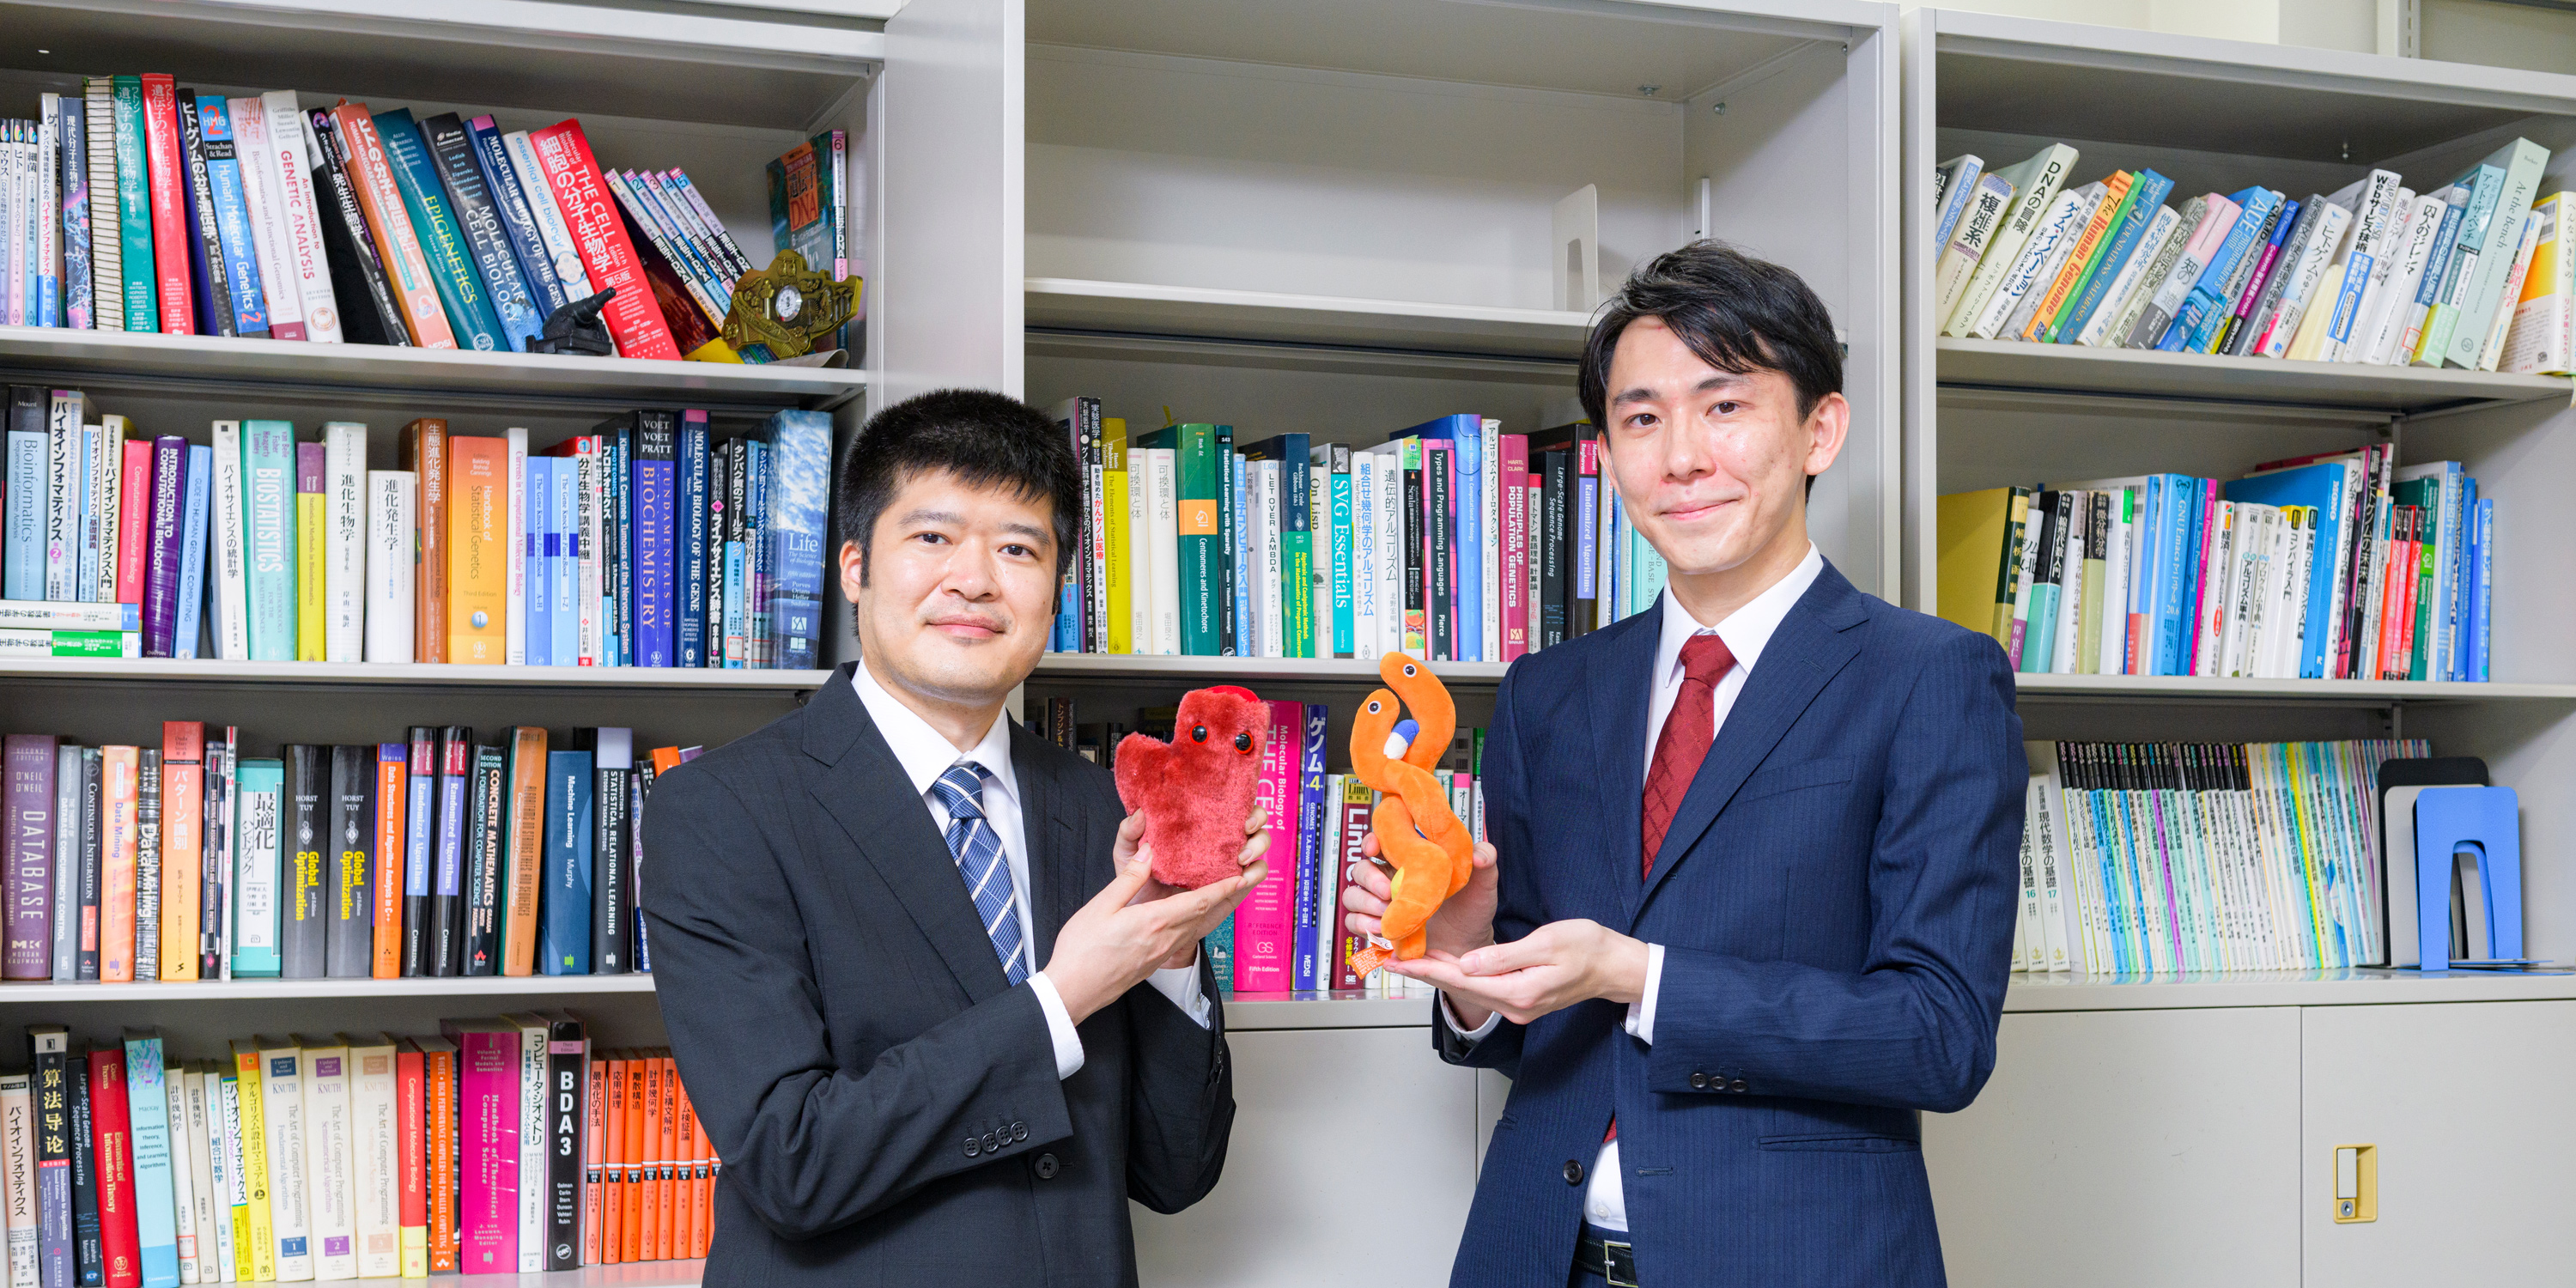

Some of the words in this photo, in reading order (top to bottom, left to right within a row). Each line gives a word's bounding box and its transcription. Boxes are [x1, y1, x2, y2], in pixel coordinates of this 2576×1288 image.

[206, 141, 233, 151] Strachan
[515, 137, 540, 185] essential
[534, 185, 549, 206] cell
[542, 208, 564, 247] biology
[540, 136, 611, 273] 細胞の分子生物学
[577, 165, 598, 200] THE
[589, 202, 617, 246] CELL
[2510, 197, 2521, 214] the
[2515, 180, 2526, 196] At
[281, 150, 301, 208] GENETIC
[292, 213, 315, 280] ANALYSIS
[303, 188, 319, 239] Introduction
[313, 240, 319, 250] to
[2242, 197, 2268, 235] ACE
[2497, 216, 2516, 249] Bench
[217, 165, 233, 202] Human
[227, 204, 243, 258] Molecular
[235, 261, 253, 309] Genetics
[423, 195, 478, 304] EPIGENETICS
[478, 205, 526, 300] MOLECULAR
[2075, 215, 2108, 260] Human
[466, 210, 483, 250] CELL
[483, 252, 519, 322] BIOLOGY
[2046, 262, 2081, 315] Genome
[643, 432, 670, 442] VOET
[644, 419, 670, 430] VOET
[641, 444, 671, 454] PRATT
[694, 429, 703, 493] MOLECULAR
[21, 440, 38, 542] Bioinformatics
[132, 466, 142, 519] Computational
[156, 447, 169, 528] COMPUTATIONAL
[165, 448, 178, 522] INTRODUCTION
[1334, 480, 1349, 517] SVG
[256, 468, 283, 573] BIOSTATISTICS
[471, 485, 482, 533] Statistical
[483, 485, 492, 530] Handbook
[692, 495, 702, 540] BIOLOGY
[1436, 495, 1444, 550] Programming
[1584, 484, 1593, 539] Randomized
[131, 520, 139, 556] Molecular
[153, 530, 162, 572] BIOLOGY
[164, 525, 173, 538] TO
[483, 532, 492, 541] of
[643, 466, 654, 629] BIOCHEMISTRY
[691, 542, 700, 556] OF
[788, 532, 819, 553] Life
[127, 557, 137, 584] Biology
[471, 535, 481, 580] Genetics
[691, 559, 700, 580] THE
[1199, 538, 1207, 578] Centromeres
[1334, 524, 1351, 608] Essentials
[1437, 553, 1445, 596] Languages
[1516, 551, 1523, 565] OF
[1583, 542, 1593, 592] Algorithms
[690, 583, 700, 611] GENE
[1200, 592, 1208, 633] Kinetochores
[2166, 605, 2179, 616] 20.6
[621, 623, 629, 654] System
[664, 609, 670, 629] OF
[488, 769, 500, 827] CONCRETE
[609, 770, 617, 828] STATISTICAL
[112, 826, 122, 858] Mining
[566, 812, 574, 848] Learning
[21, 811, 46, 919] DATABASE
[294, 851, 307, 920] Optimization
[308, 851, 319, 886] Global
[483, 830, 496, 906] MATHEMATICS
[565, 860, 574, 888] Murphy
[2026, 890, 2036, 898] 16
[2047, 890, 2057, 898] 17
[43, 1069, 64, 1154] 算法导论
[79, 1073, 89, 1119] Large-Scale
[72, 1105, 81, 1141] Sequence
[75, 1143, 84, 1186] Processing
[104, 1133, 114, 1182] Information
[114, 1132, 124, 1171] Elements
[106, 1182, 116, 1212] Theory
[117, 1172, 125, 1182] of
